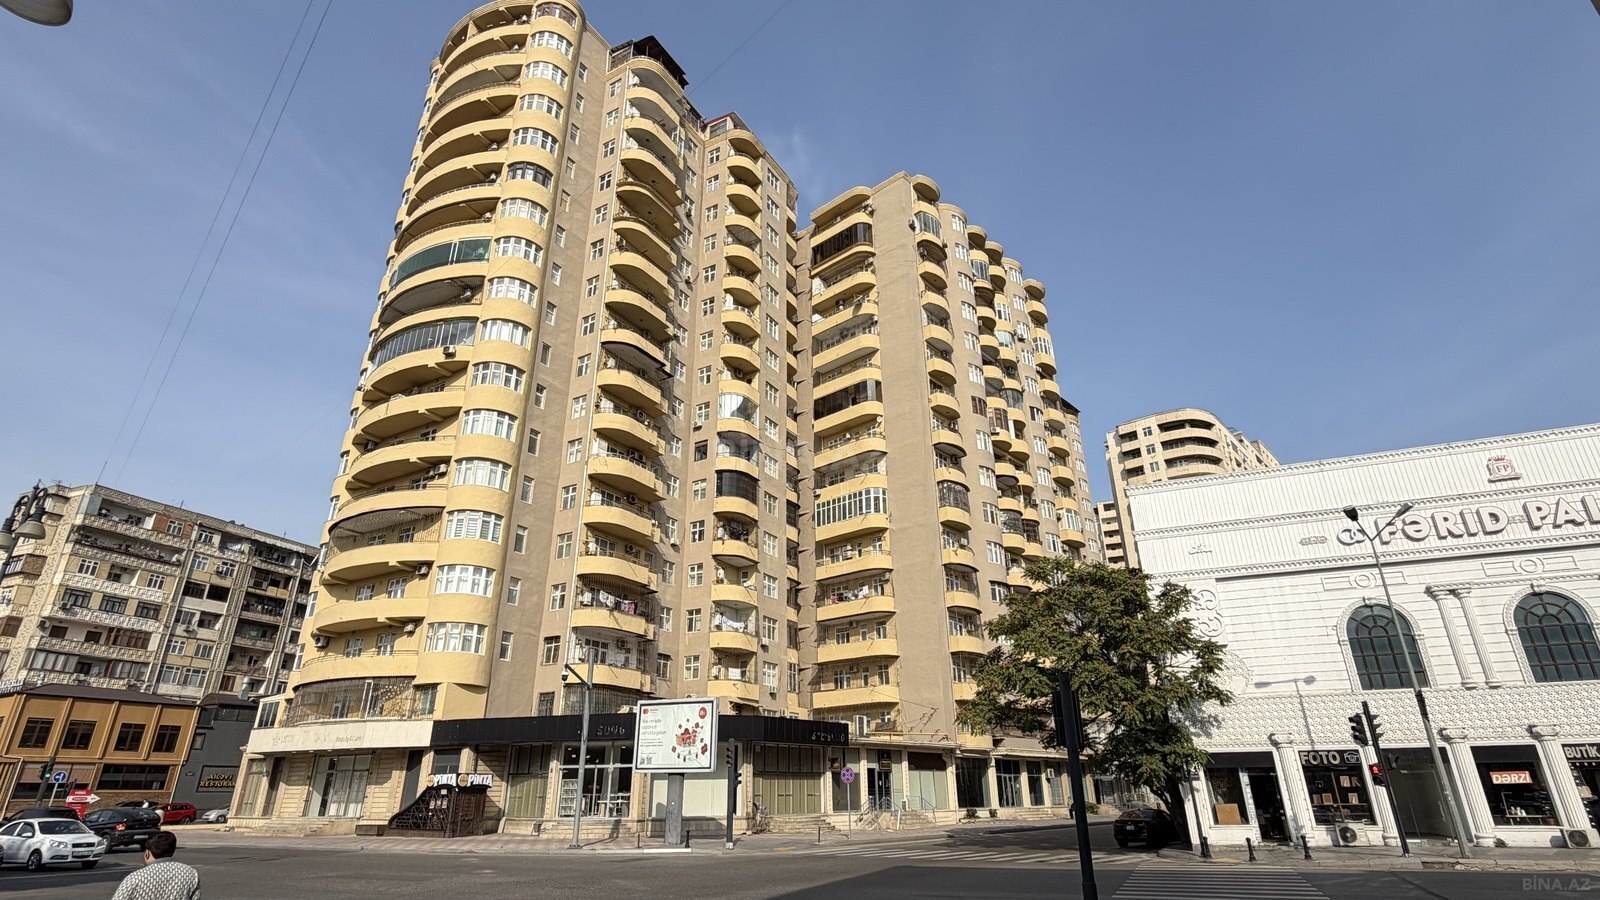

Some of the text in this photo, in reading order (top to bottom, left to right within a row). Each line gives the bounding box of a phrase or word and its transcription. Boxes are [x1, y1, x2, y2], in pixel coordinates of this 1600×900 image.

[1495, 464, 1509, 473] FP
[1564, 744, 1600, 758] BUTİK
[1300, 751, 1341, 765] FOTO
[1492, 771, 1531, 784] DƏRZİ
